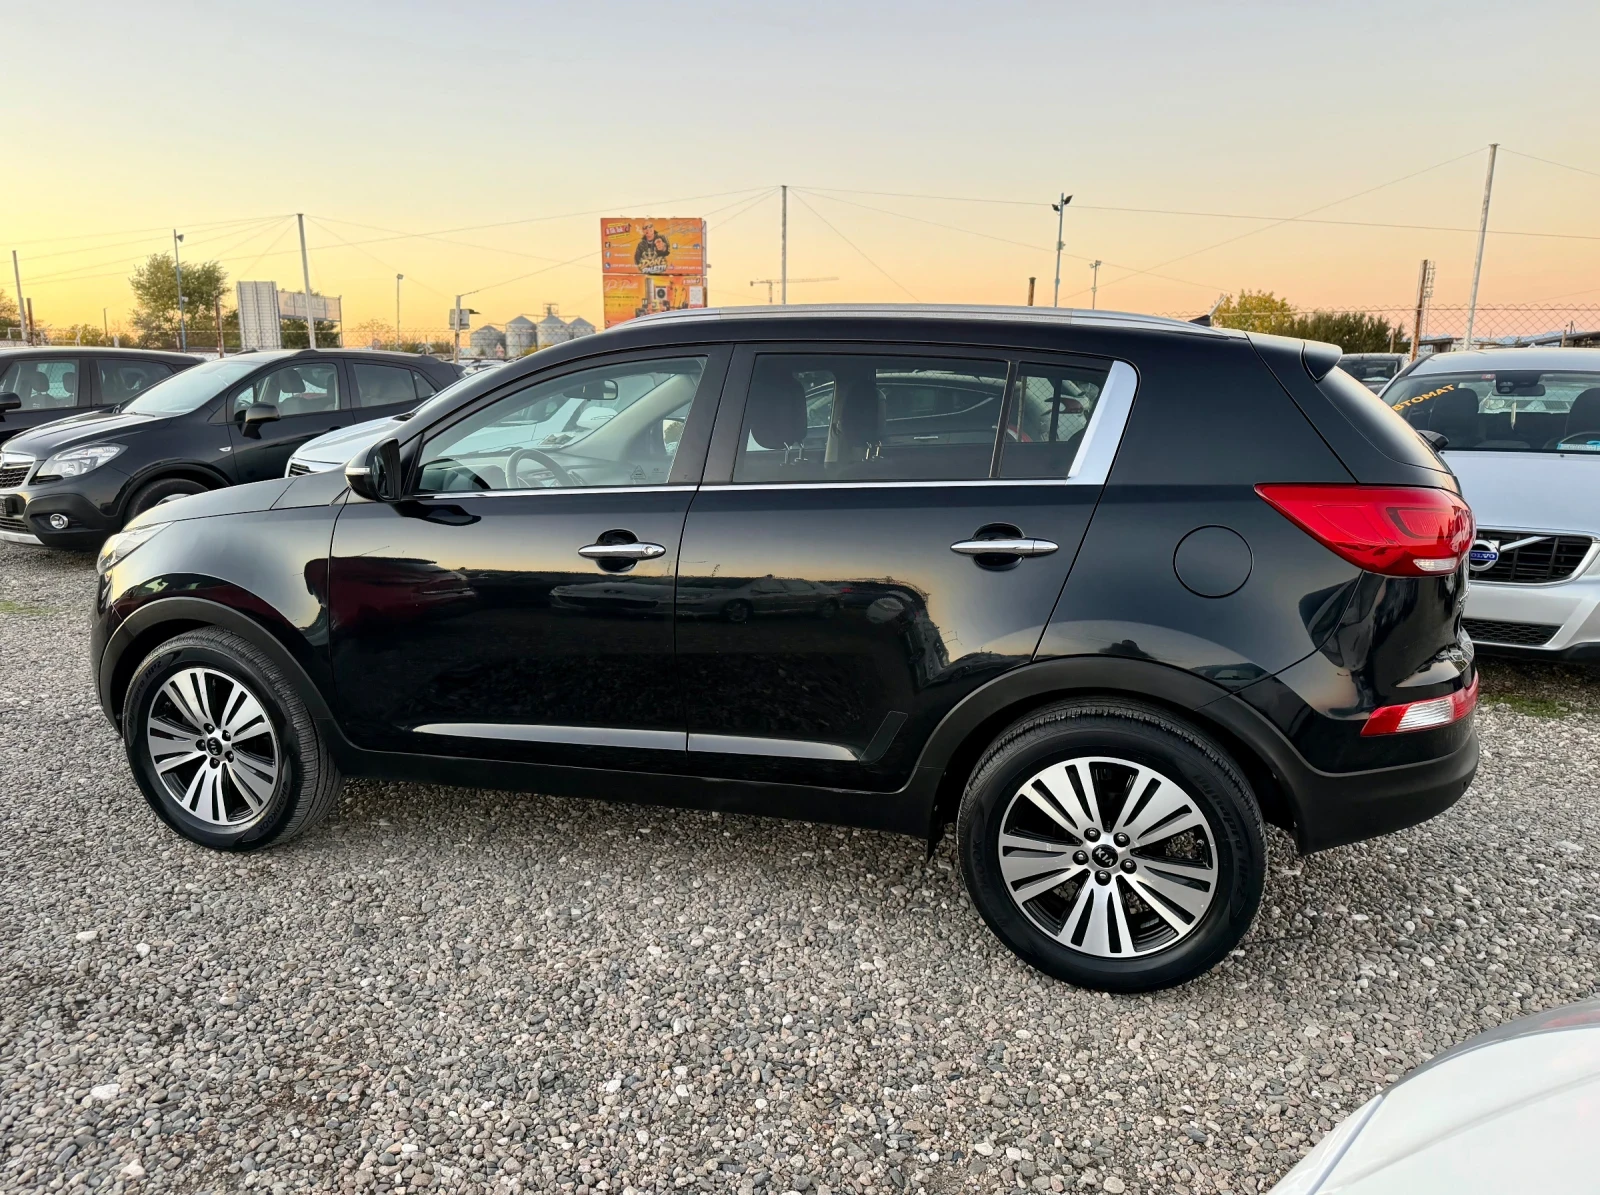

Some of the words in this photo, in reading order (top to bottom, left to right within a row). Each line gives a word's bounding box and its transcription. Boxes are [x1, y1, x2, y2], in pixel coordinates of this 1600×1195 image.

[1391, 384, 1455, 411] ВТОМАТ
[209, 739, 219, 755] KIA
[1095, 847, 1113, 866] KIA
